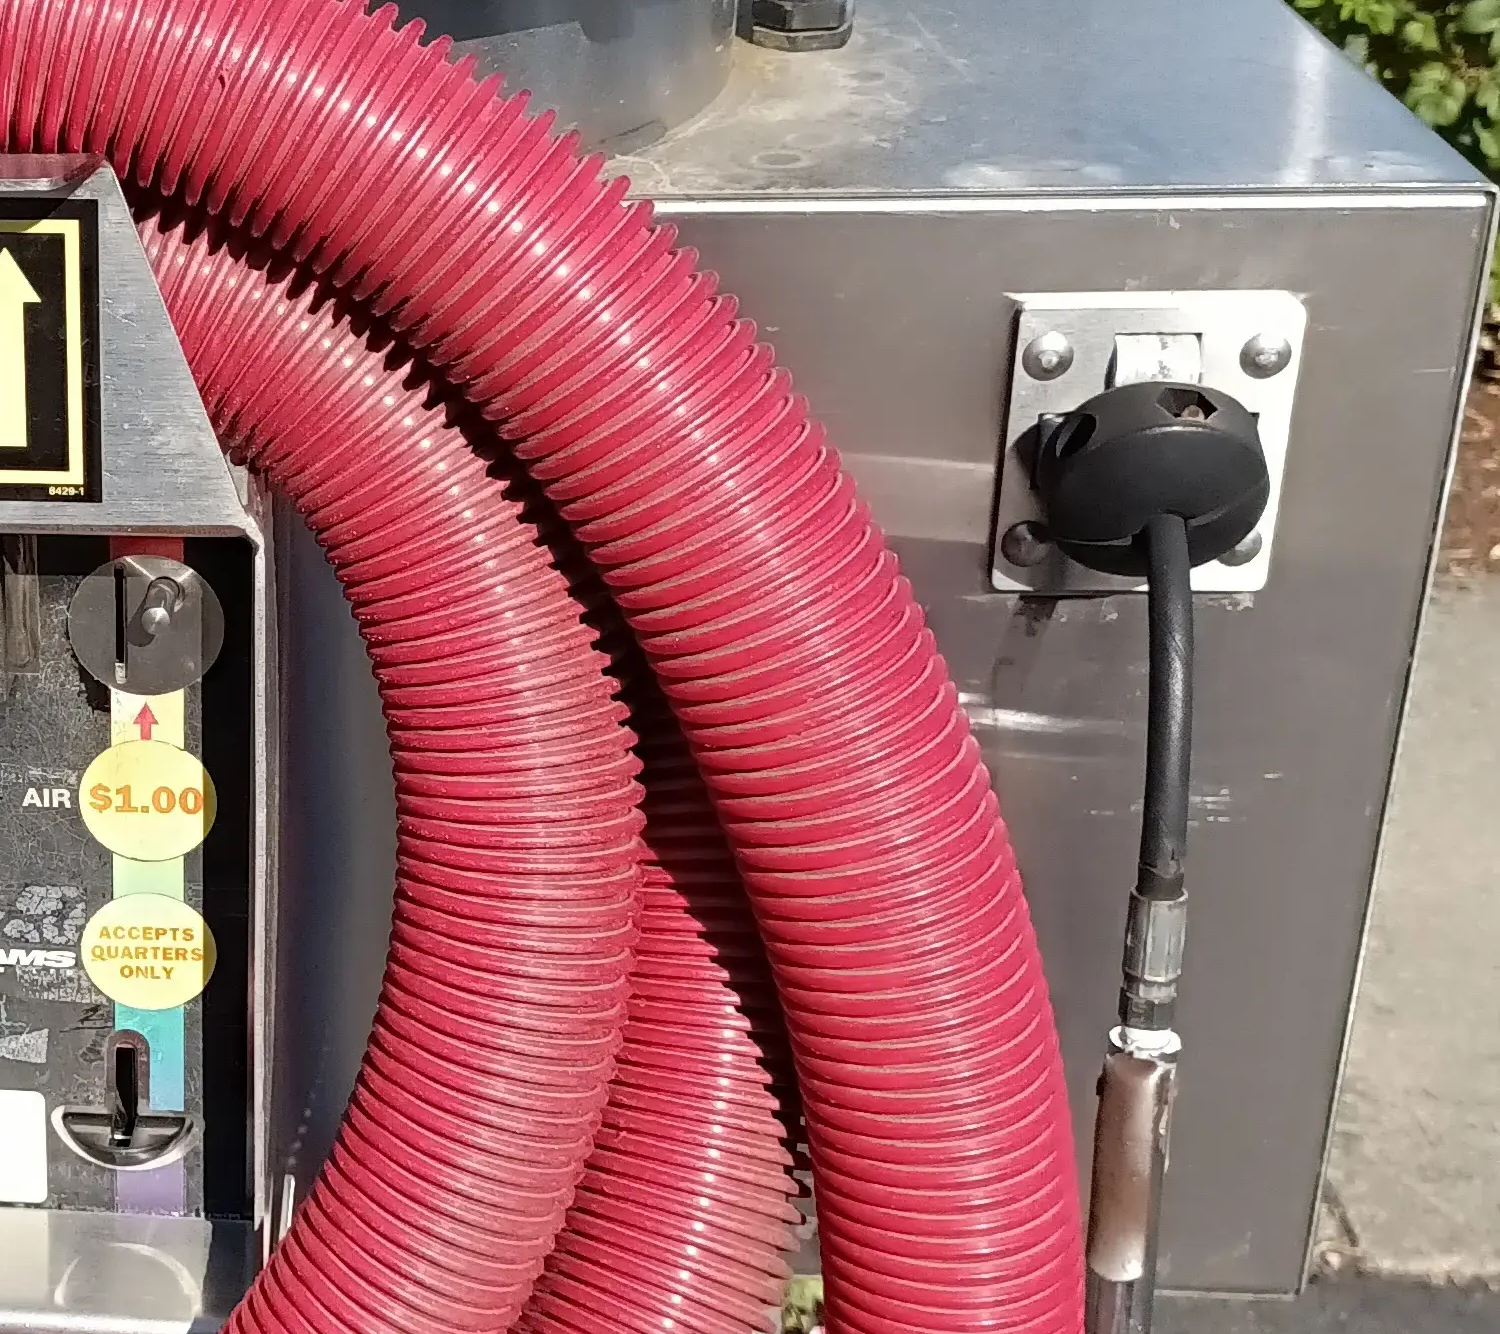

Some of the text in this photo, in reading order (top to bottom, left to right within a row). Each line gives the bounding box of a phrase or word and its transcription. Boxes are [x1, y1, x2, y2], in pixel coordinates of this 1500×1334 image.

[22, 787, 71, 809] AIR
[89, 782, 204, 815] $1.00
[99, 926, 195, 941] ACCEPTS
[91, 945, 204, 962] QUARTERS
[119, 964, 174, 979] ONLY
